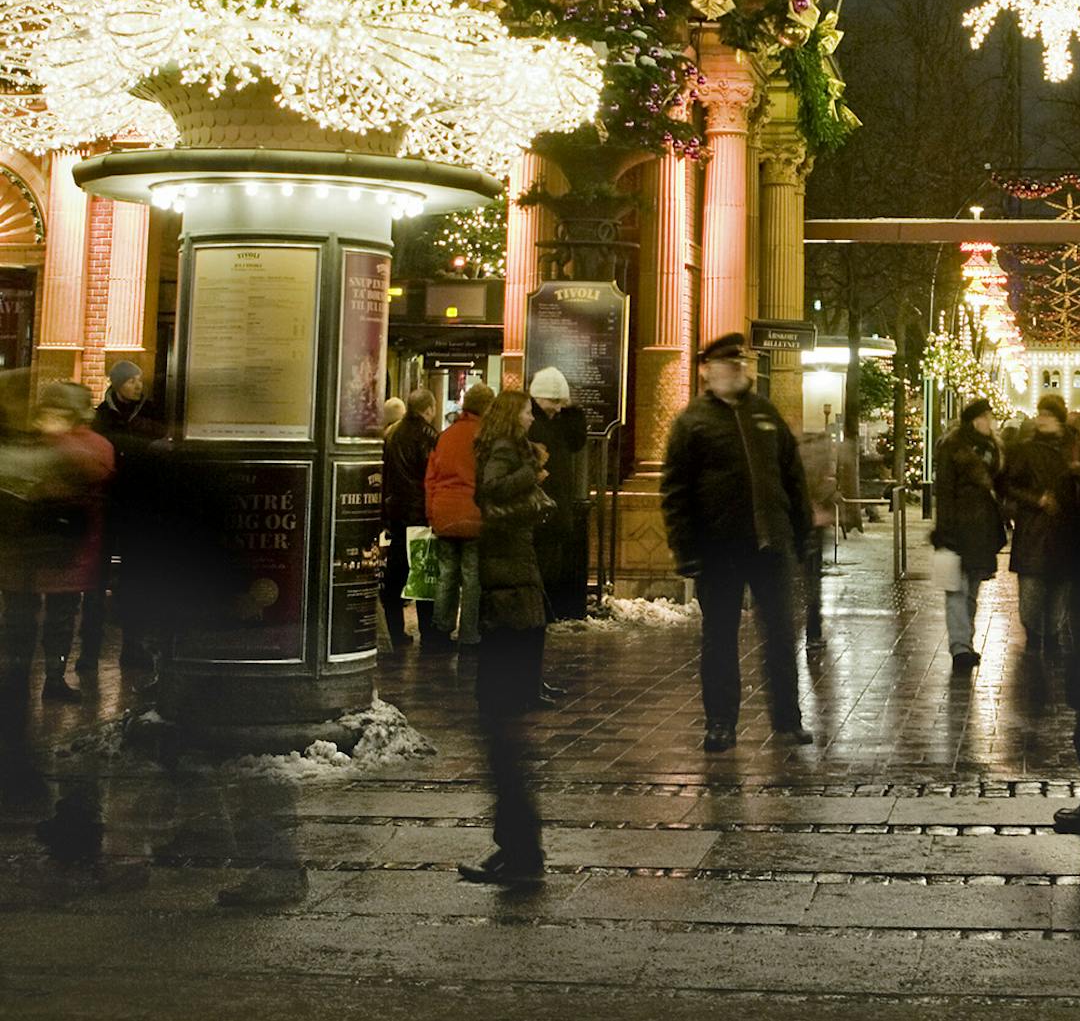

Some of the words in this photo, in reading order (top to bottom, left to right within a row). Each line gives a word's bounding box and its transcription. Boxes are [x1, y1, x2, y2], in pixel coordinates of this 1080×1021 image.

[554, 287, 600, 301] TIVOLI
[340, 493, 361, 505] THE
[264, 513, 297, 531] OG
